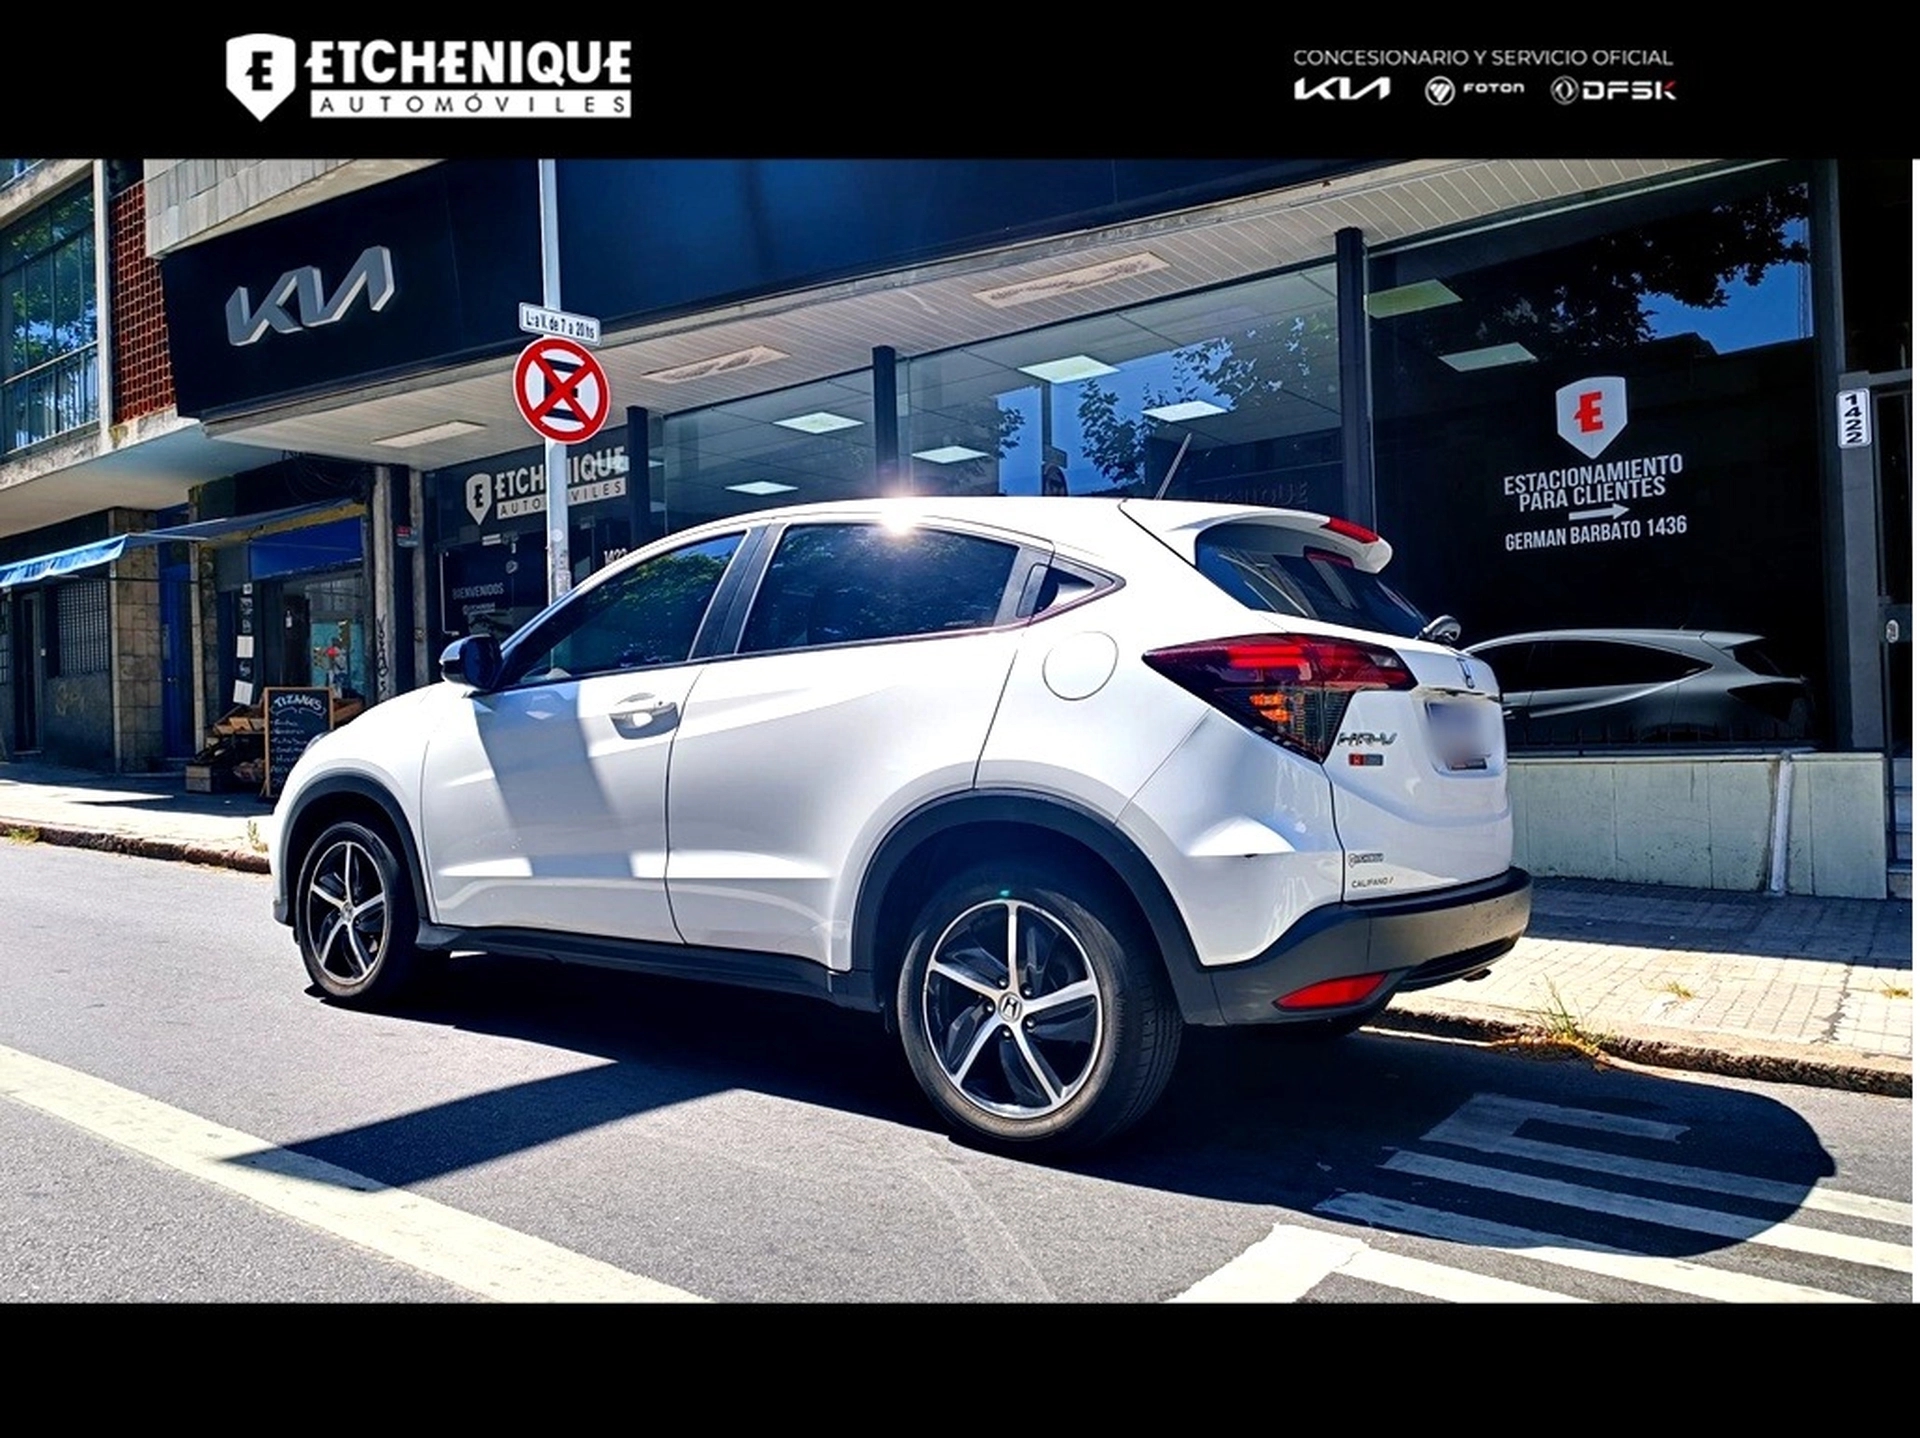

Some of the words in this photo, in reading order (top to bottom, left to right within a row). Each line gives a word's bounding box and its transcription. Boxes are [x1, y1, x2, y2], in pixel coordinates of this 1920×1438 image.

[225, 245, 395, 347] KIA
[576, 321, 585, 337] 20
[1844, 394, 1863, 443] 1422
[1503, 453, 1684, 496] ESTACIONAMIENTO
[1519, 488, 1568, 513] PARA
[1573, 476, 1666, 506] CLIENTES
[1505, 527, 1566, 551] GERMAN
[1570, 519, 1641, 545] BARBATO
[1646, 515, 1688, 537] 1436
[452, 582, 505, 600] BIENVENIDOS
